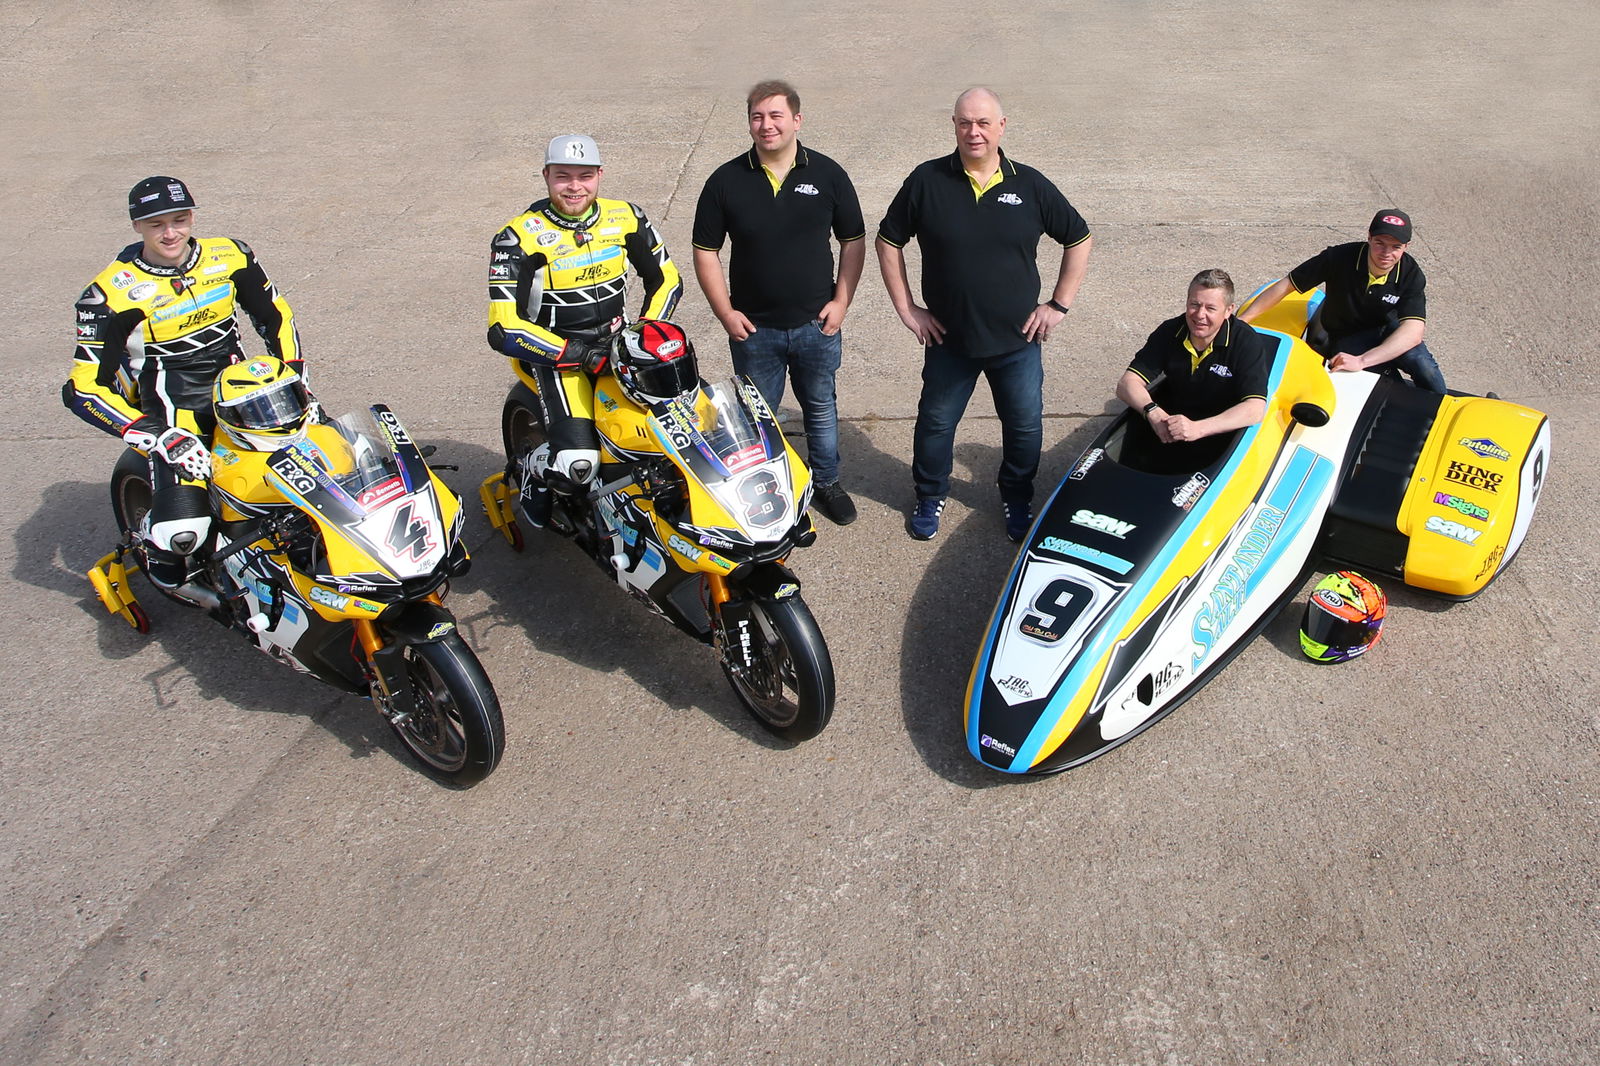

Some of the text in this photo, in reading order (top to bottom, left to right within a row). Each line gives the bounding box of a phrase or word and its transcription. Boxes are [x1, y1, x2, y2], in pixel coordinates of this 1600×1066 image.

[515, 337, 546, 357] Putoline
[83, 400, 113, 426] Putoline
[666, 401, 693, 435] Putoline
[380, 411, 413, 445] R&G
[656, 412, 691, 450] R&G
[1459, 437, 1509, 458] Putoline
[285, 446, 320, 478] Putoline
[1449, 460, 1504, 484] KING
[272, 458, 316, 495] R&G
[1445, 469, 1498, 493] DICK
[737, 469, 789, 528] 8
[385, 501, 435, 562] 4
[1071, 509, 1137, 536] saw
[1425, 516, 1482, 542] saw
[668, 534, 703, 560] saw
[309, 586, 350, 610] saw
[1192, 507, 1285, 676] SANTANDER
[1322, 590, 1340, 604] Arai
[1016, 577, 1095, 644] 9
[738, 620, 751, 667] PIRELLI
[1007, 674, 1030, 689] TAG
[991, 739, 1016, 755] Reflex
